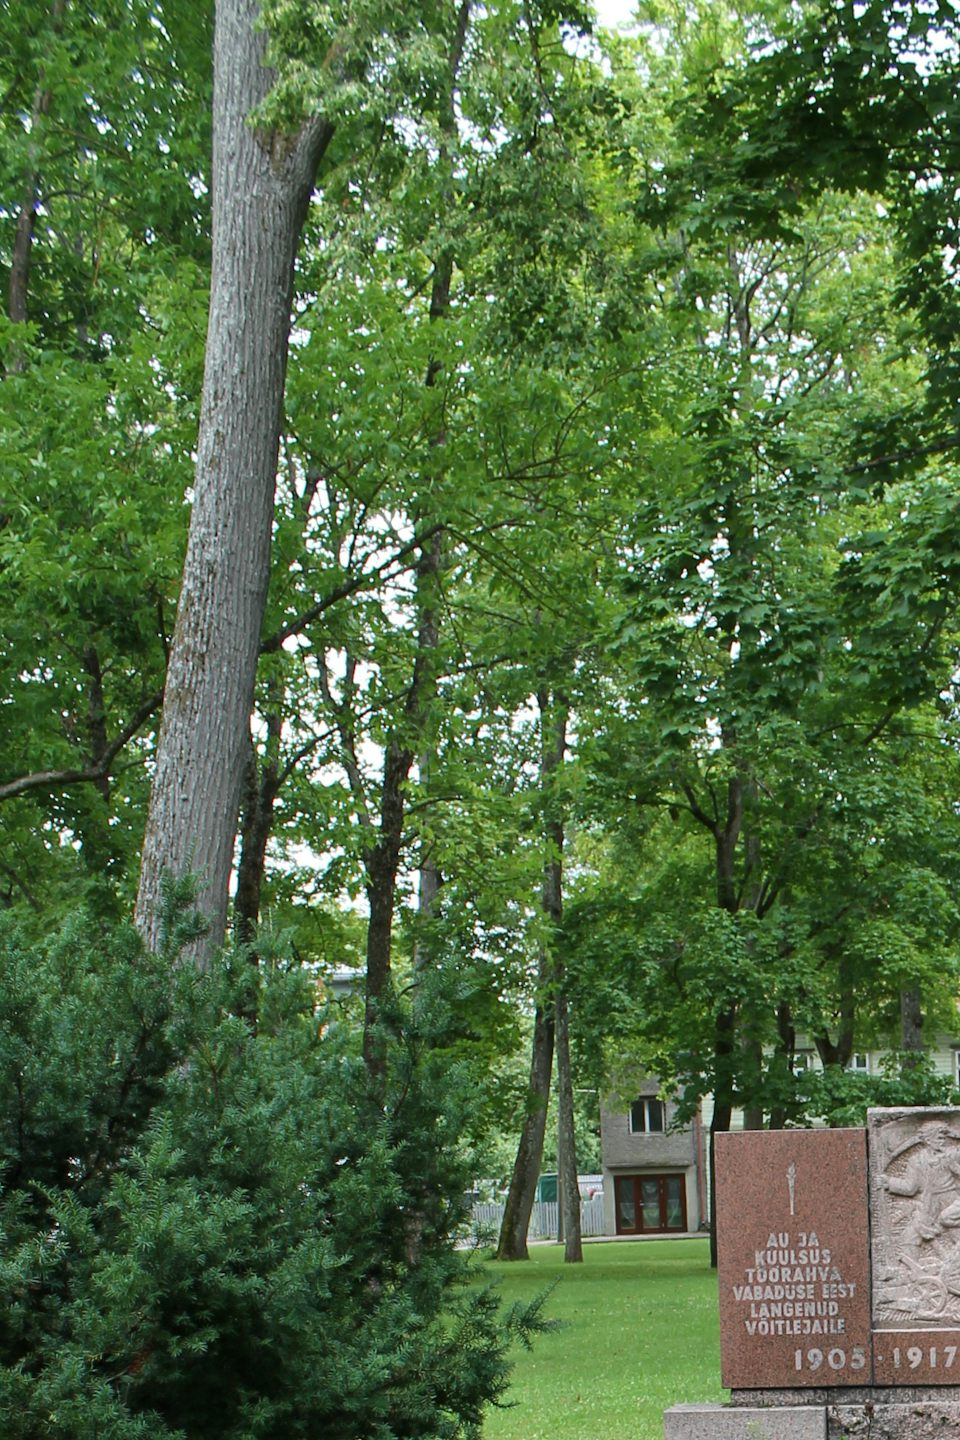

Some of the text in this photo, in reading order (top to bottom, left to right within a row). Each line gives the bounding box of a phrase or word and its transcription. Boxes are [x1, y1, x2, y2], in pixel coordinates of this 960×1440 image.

[766, 1232, 819, 1248] AU JA
[755, 1249, 831, 1266] KUULSUS
[745, 1266, 841, 1283] TÖÖRAHVA
[822, 1284, 857, 1298] EEST
[751, 1301, 839, 1318] LANGENUD
[745, 1316, 845, 1335] VÕITLEJAILE
[795, 1347, 866, 1371] 1905
[893, 1346, 957, 1369] 1917
